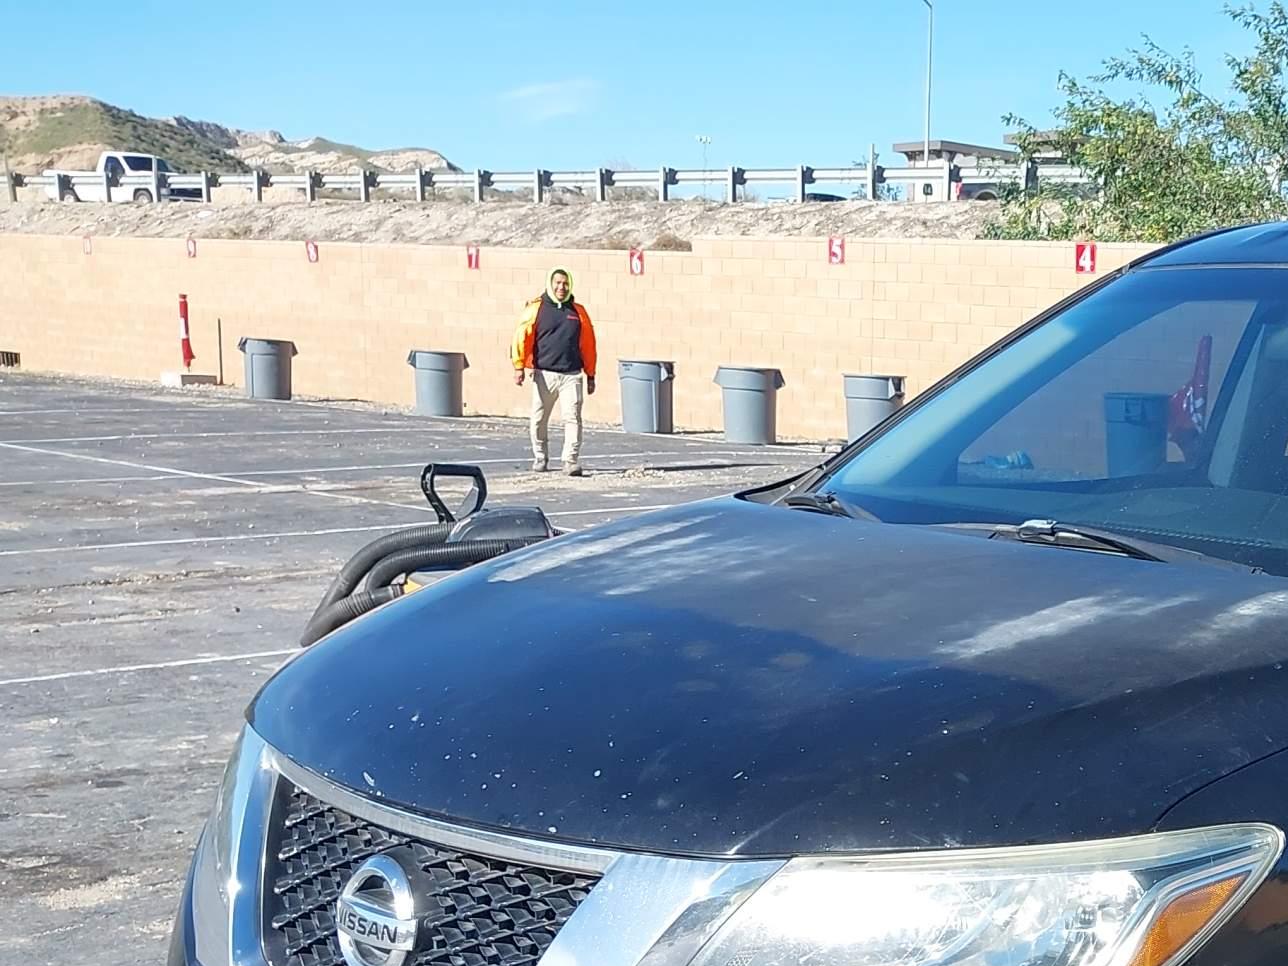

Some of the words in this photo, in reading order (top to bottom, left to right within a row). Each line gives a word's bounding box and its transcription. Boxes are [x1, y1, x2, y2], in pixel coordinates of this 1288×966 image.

[631, 246, 643, 274] 6
[831, 238, 842, 263] 5
[1079, 244, 1094, 271] 4
[339, 907, 398, 944] NISSAN
